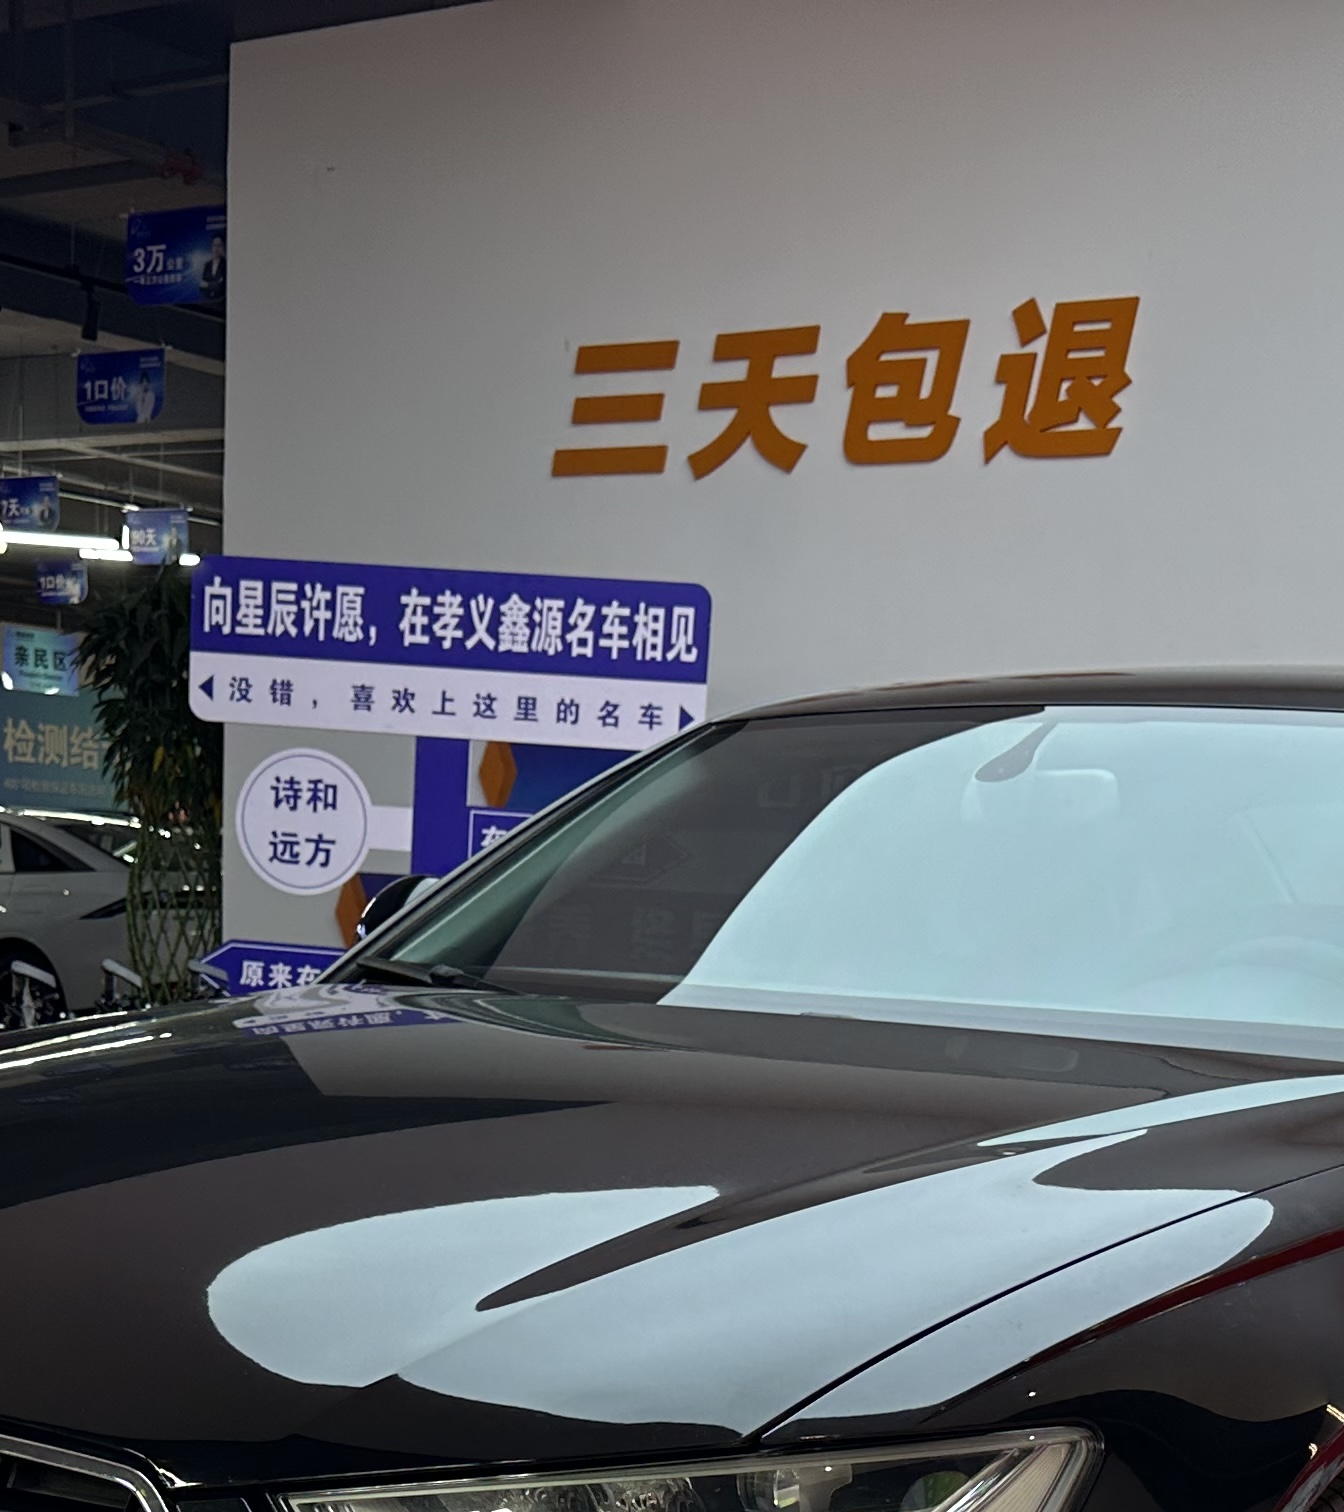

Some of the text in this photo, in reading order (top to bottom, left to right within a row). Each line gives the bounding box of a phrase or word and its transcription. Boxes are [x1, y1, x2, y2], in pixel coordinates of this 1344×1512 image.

[84, 376, 126, 401] 1口价
[552, 296, 1140, 481] 三天包退
[4, 717, 111, 770] 检测结
[270, 775, 338, 814] 诗和
[268, 831, 337, 869] 远方
